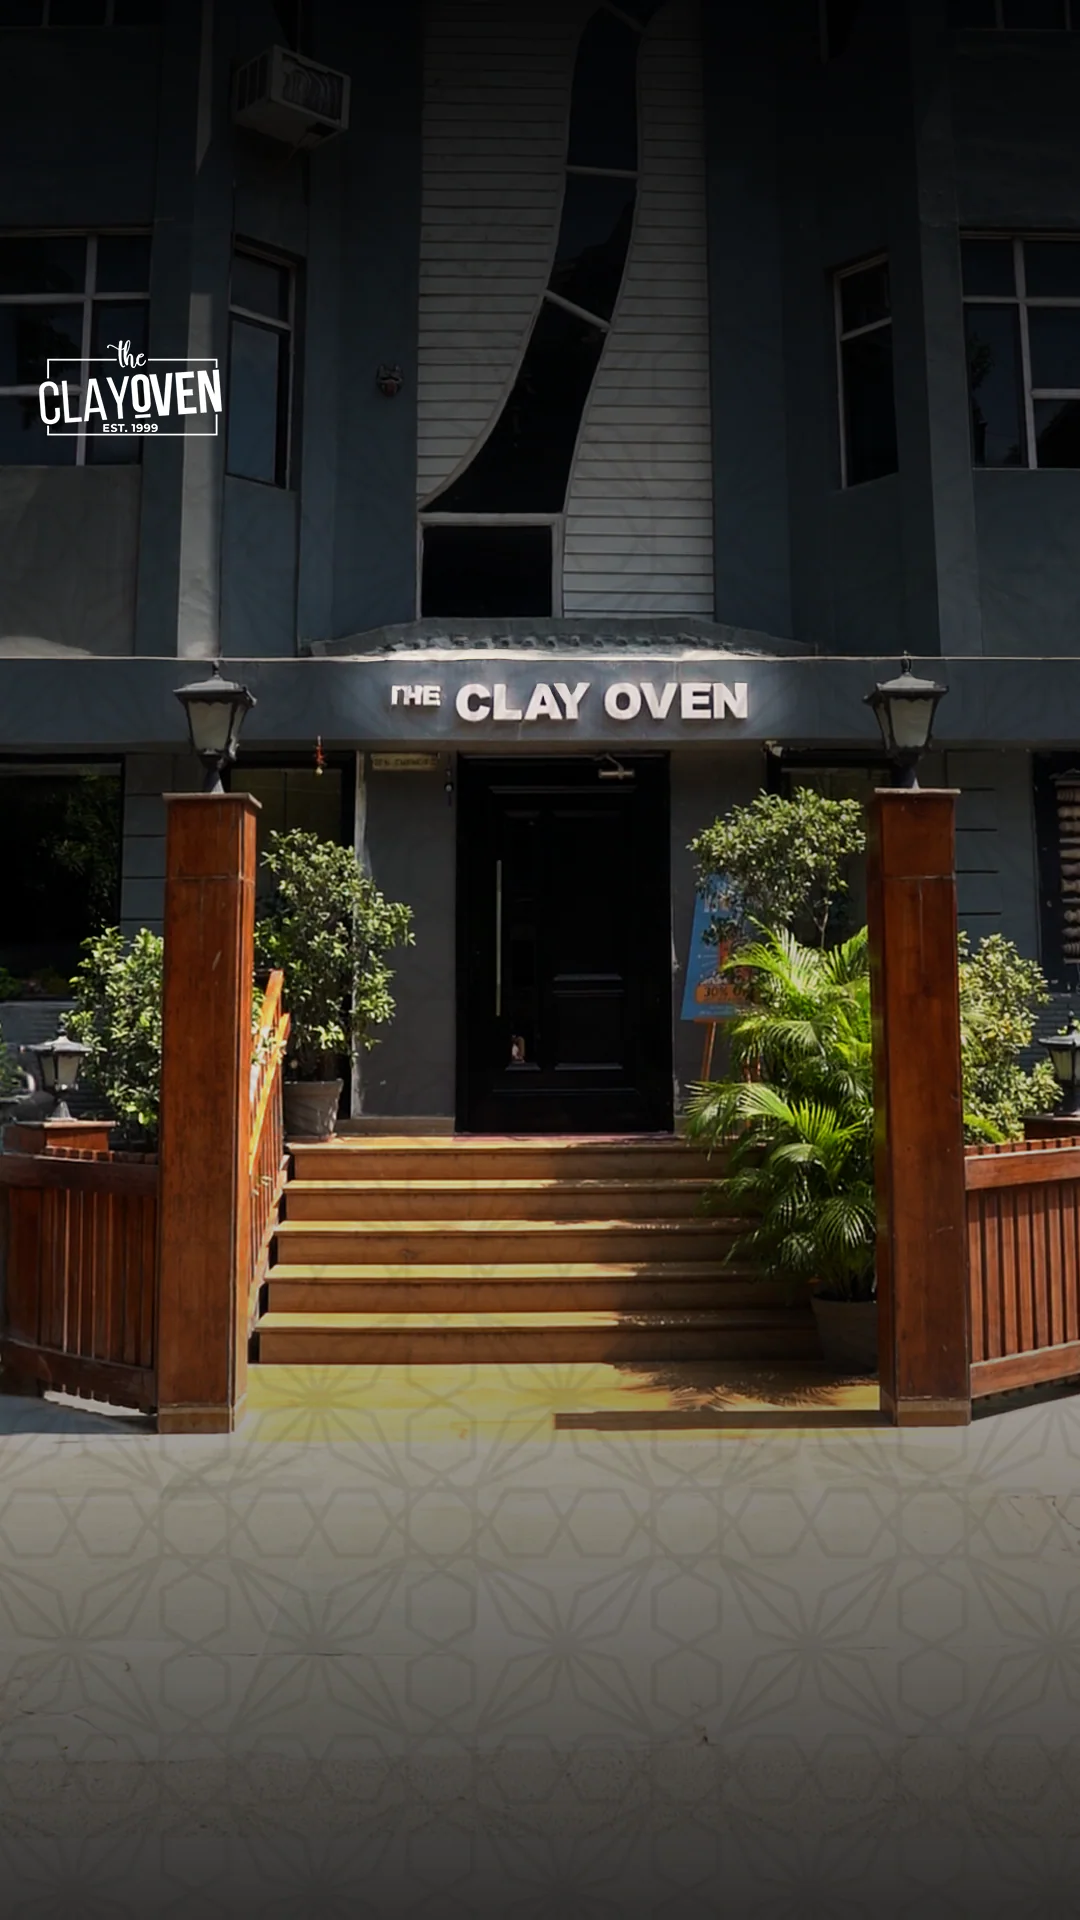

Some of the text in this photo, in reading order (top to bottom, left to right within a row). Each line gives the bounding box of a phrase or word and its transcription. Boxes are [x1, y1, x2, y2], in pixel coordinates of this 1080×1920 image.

[390, 682, 749, 722] THE CLAY OVEN
